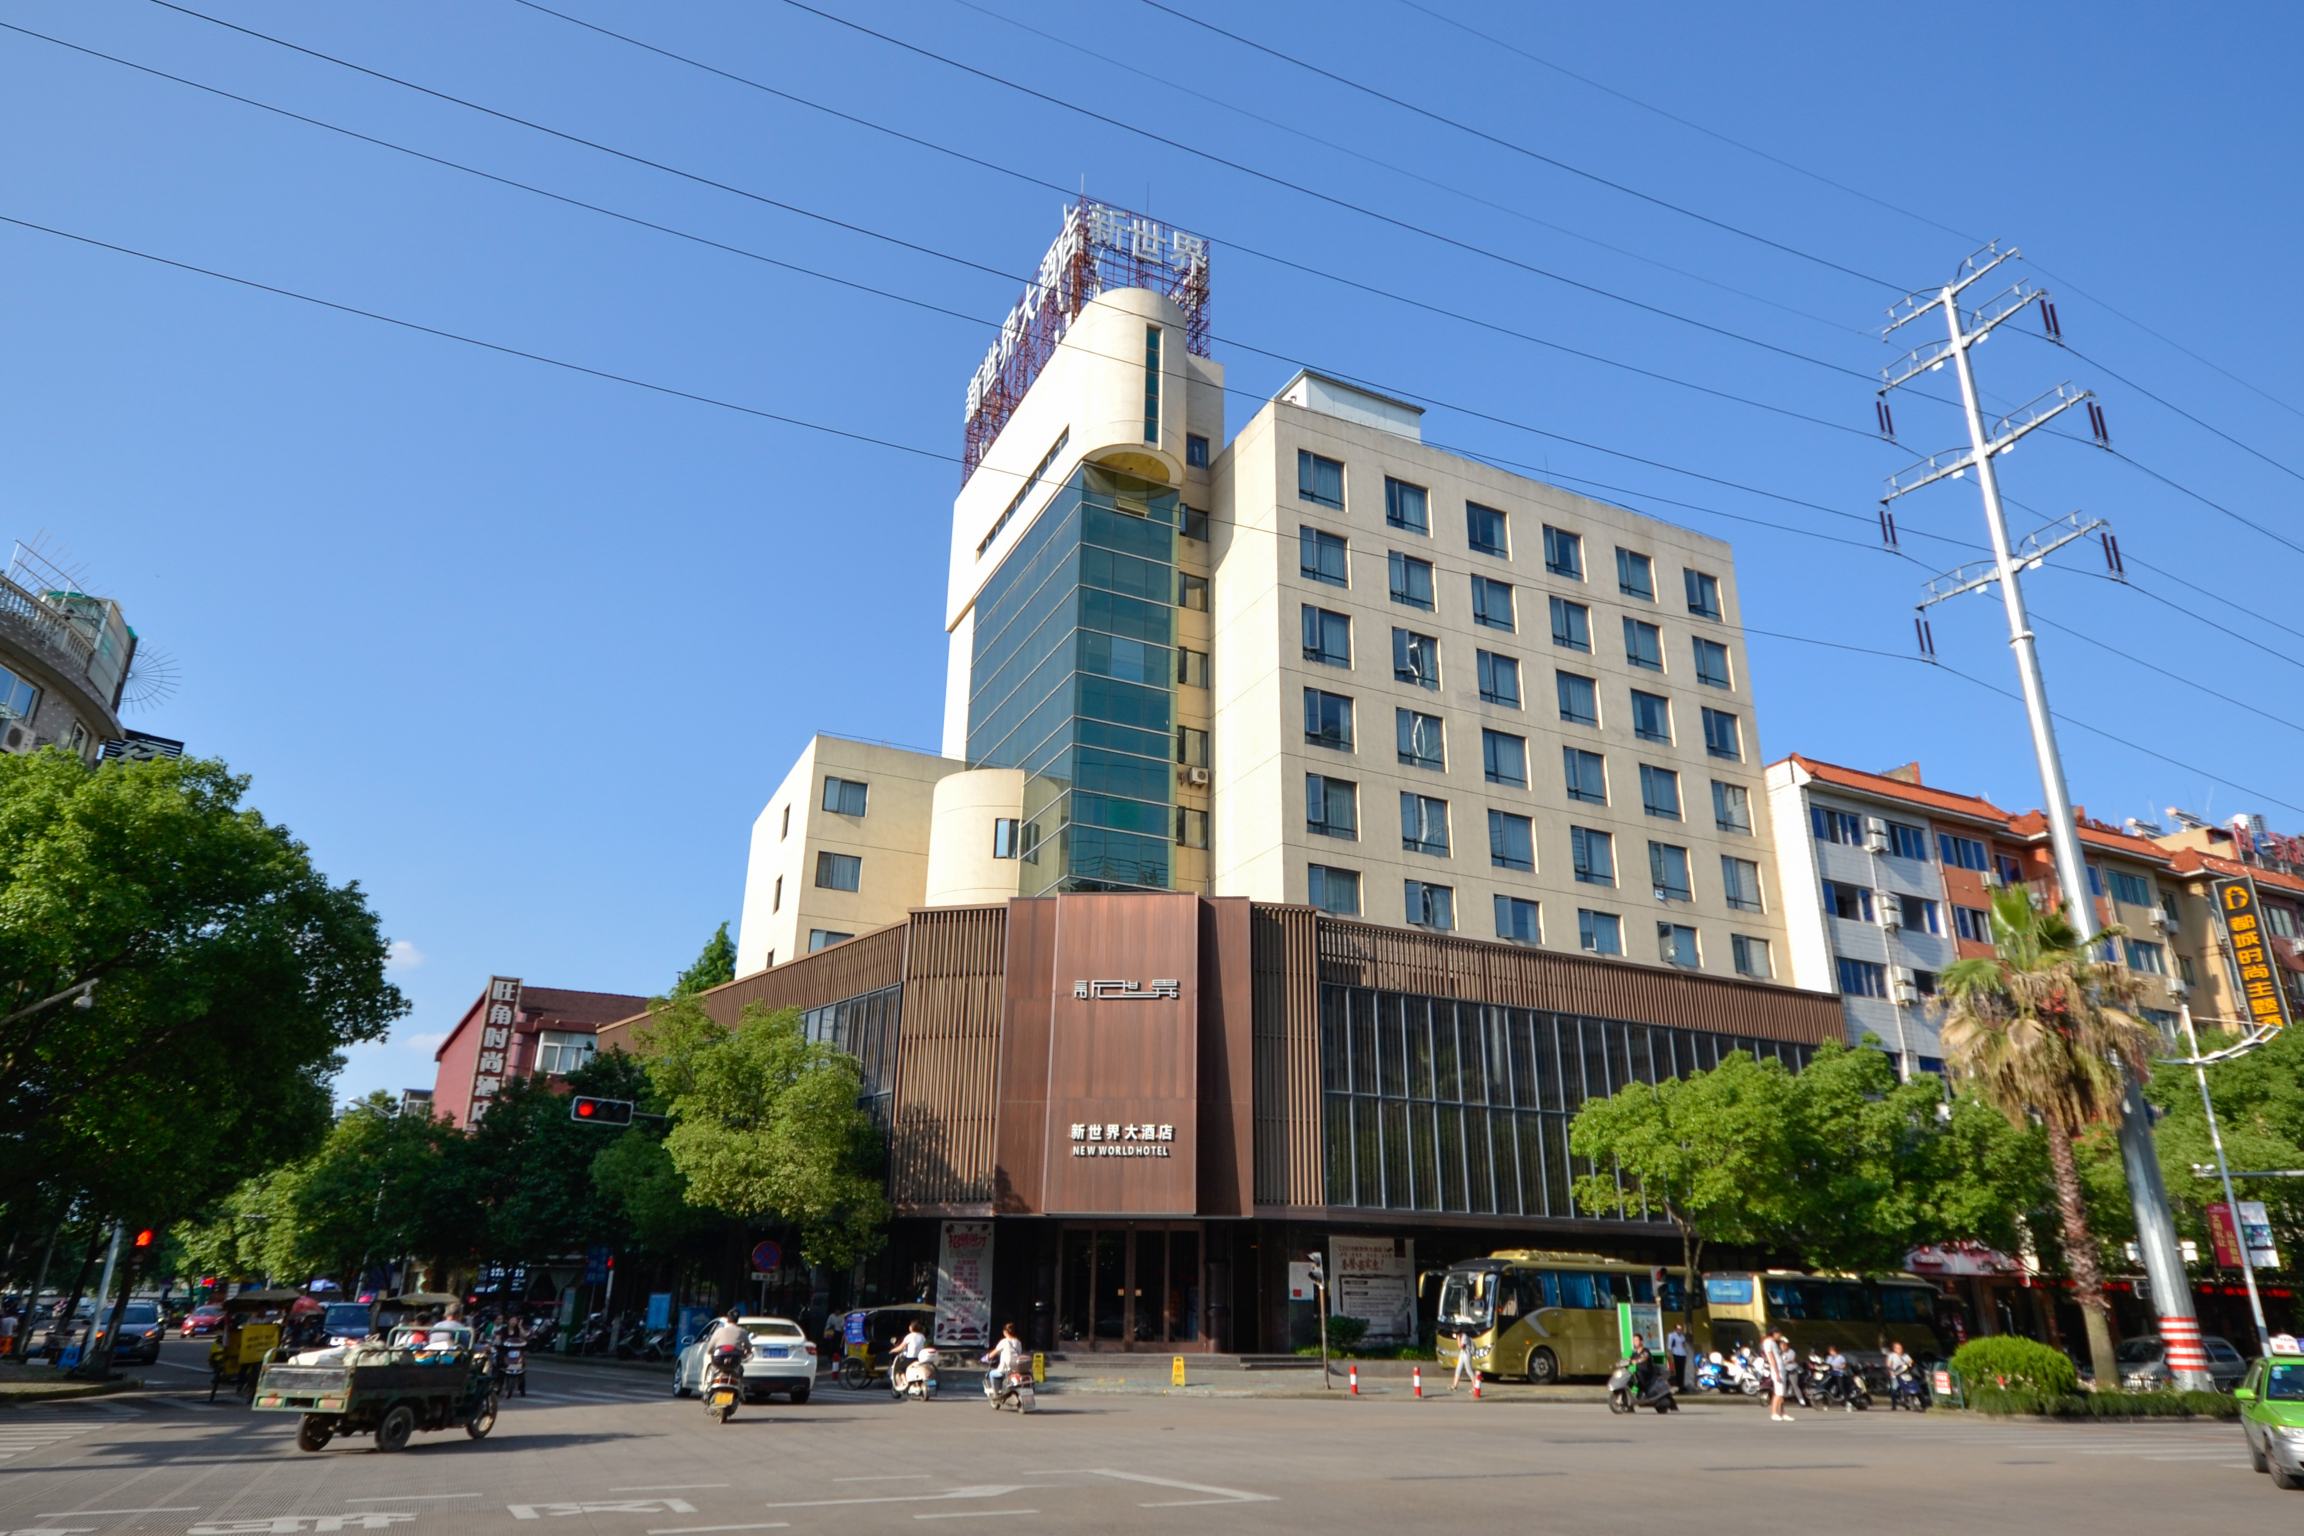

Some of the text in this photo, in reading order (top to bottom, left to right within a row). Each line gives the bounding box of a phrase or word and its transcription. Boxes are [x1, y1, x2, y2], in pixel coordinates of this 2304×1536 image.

[1087, 203, 1208, 275] 新世界
[964, 203, 1081, 424] 新世界大酒店
[1070, 1123, 1174, 1141] 新世界大酒店
[1072, 1145, 1168, 1156] NEW WORLD HOTEL
